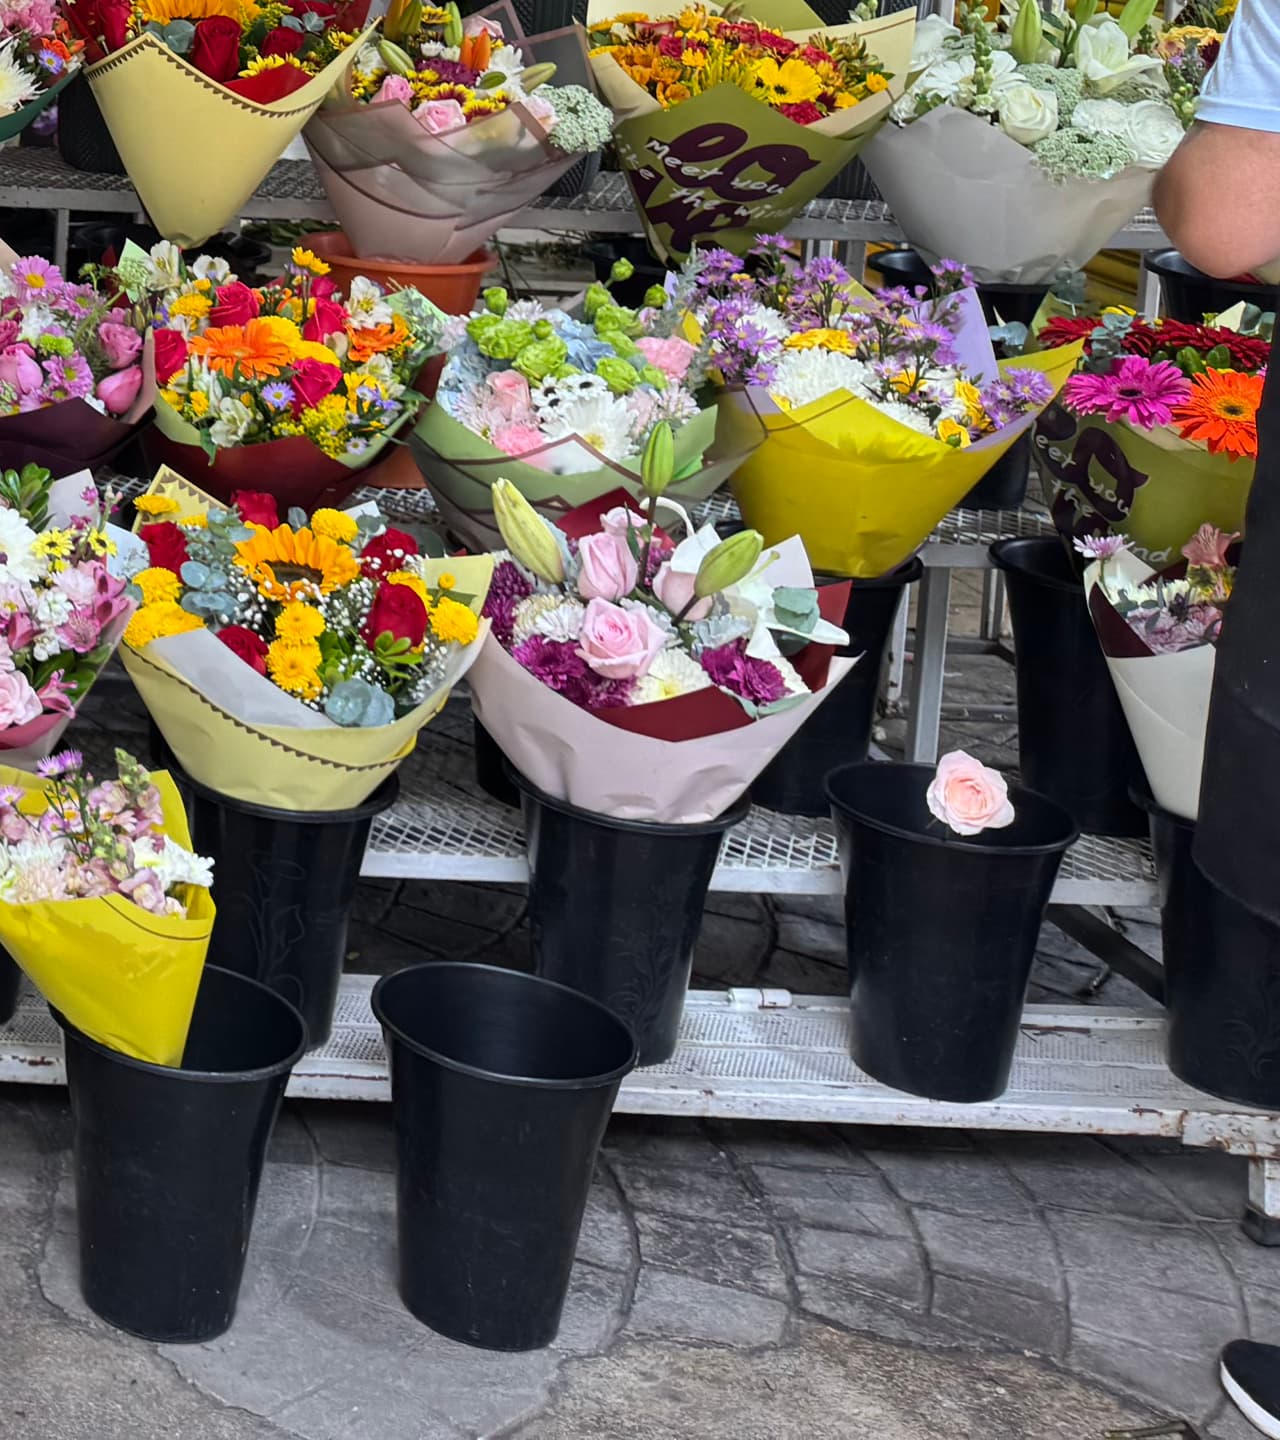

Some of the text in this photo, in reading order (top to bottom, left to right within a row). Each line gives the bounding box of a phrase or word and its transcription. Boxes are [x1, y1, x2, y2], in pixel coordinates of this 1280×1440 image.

[669, 185, 721, 211] the
[729, 177, 785, 195] you
[1035, 433, 1130, 516] eet you
[1051, 479, 1092, 517] the
